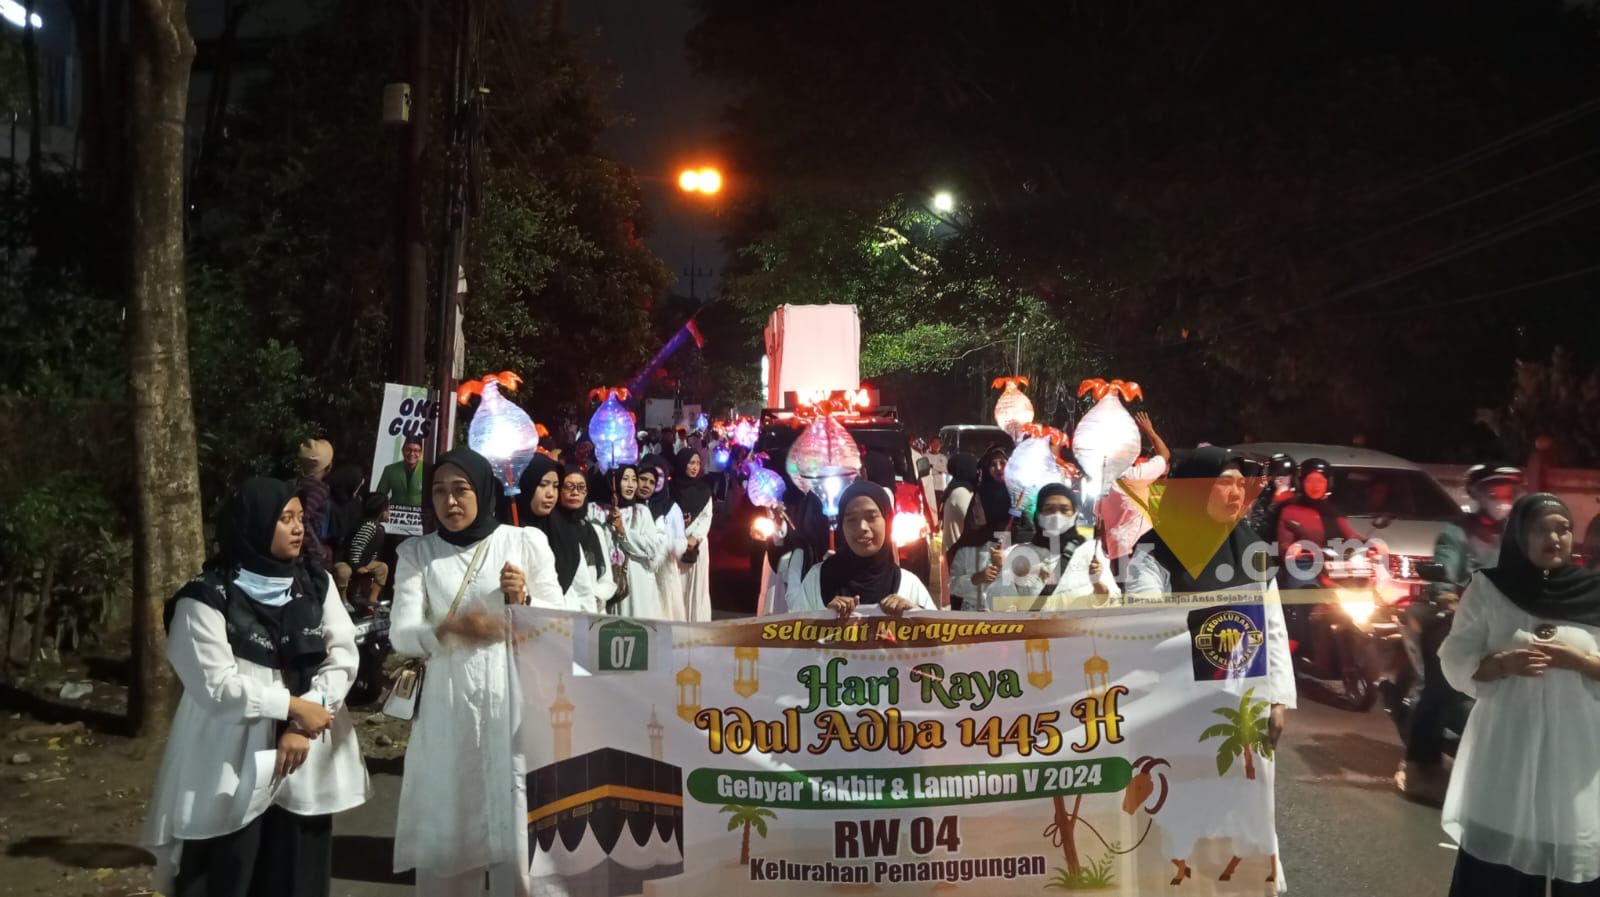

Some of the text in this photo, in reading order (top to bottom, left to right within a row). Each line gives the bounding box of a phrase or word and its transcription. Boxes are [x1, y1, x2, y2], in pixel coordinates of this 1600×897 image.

[389, 417, 431, 439] GUS
[762, 620, 1025, 642] Selamat Merayakan
[610, 636, 636, 668] 07
[797, 656, 1023, 713] Hari Raya
[694, 685, 1129, 757] Idul Adha 1445 H
[717, 763, 1103, 802] Gebyar Takbir & Lampion V 2024
[834, 814, 961, 859] RW 04
[750, 854, 1046, 884] Kelurahan Penanggungan
